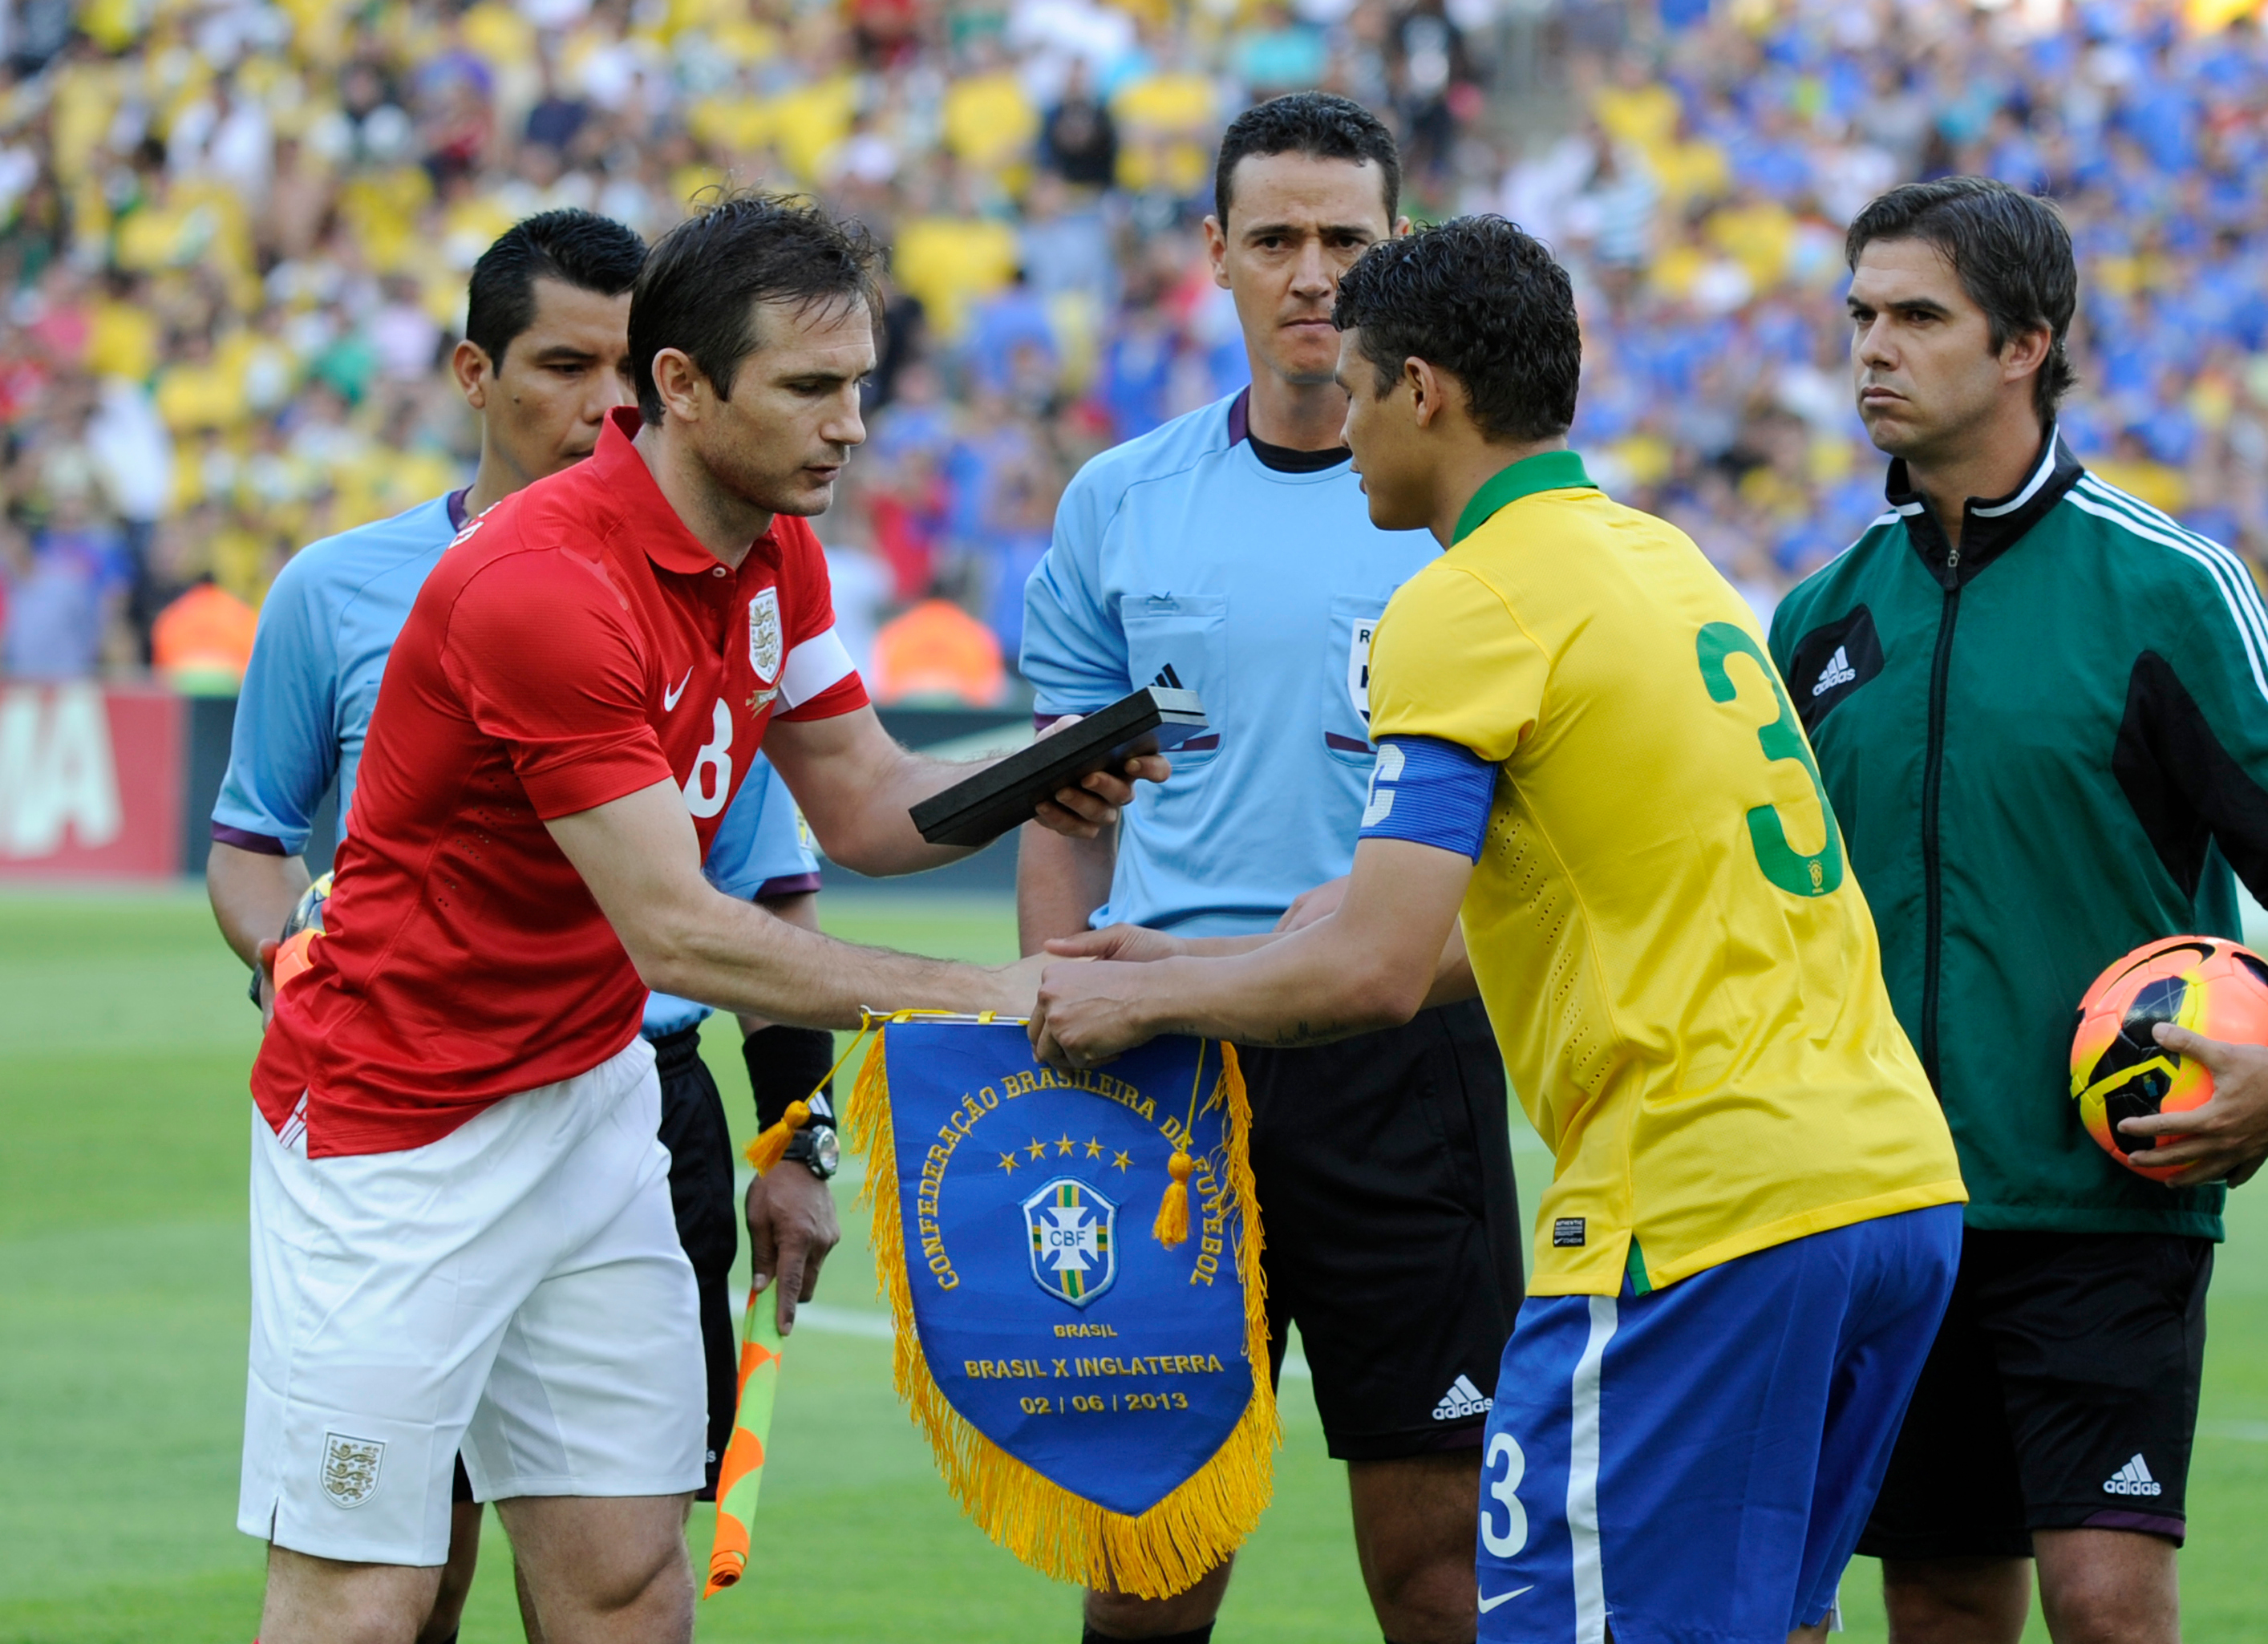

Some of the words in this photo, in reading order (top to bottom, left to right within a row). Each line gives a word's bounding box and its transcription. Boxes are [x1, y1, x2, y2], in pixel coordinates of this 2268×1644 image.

[1812, 668, 1856, 696] adidas
[682, 698, 733, 819] 8
[1696, 621, 1843, 898] 3
[917, 1086, 999, 1292] CONFEDERAÇÃO
[1001, 1067, 1157, 1122] BRASILEIRA
[1159, 1115, 1193, 1151] DE
[1189, 1155, 1224, 1287] FUTEBOL
[1050, 1230, 1086, 1246] CBF
[1053, 1324, 1118, 1338] BRASIL
[964, 1359, 1047, 1379] BRASIL
[1051, 1358, 1070, 1378] X
[1075, 1354, 1224, 1377] INGLATERRA
[1019, 1396, 1052, 1415] 02
[1071, 1395, 1105, 1412] 06
[1124, 1392, 1189, 1411] 2013
[1432, 1397, 1494, 1420] adidas
[1480, 1432, 1528, 1558] 3
[2103, 1480, 2161, 1496] adidas
